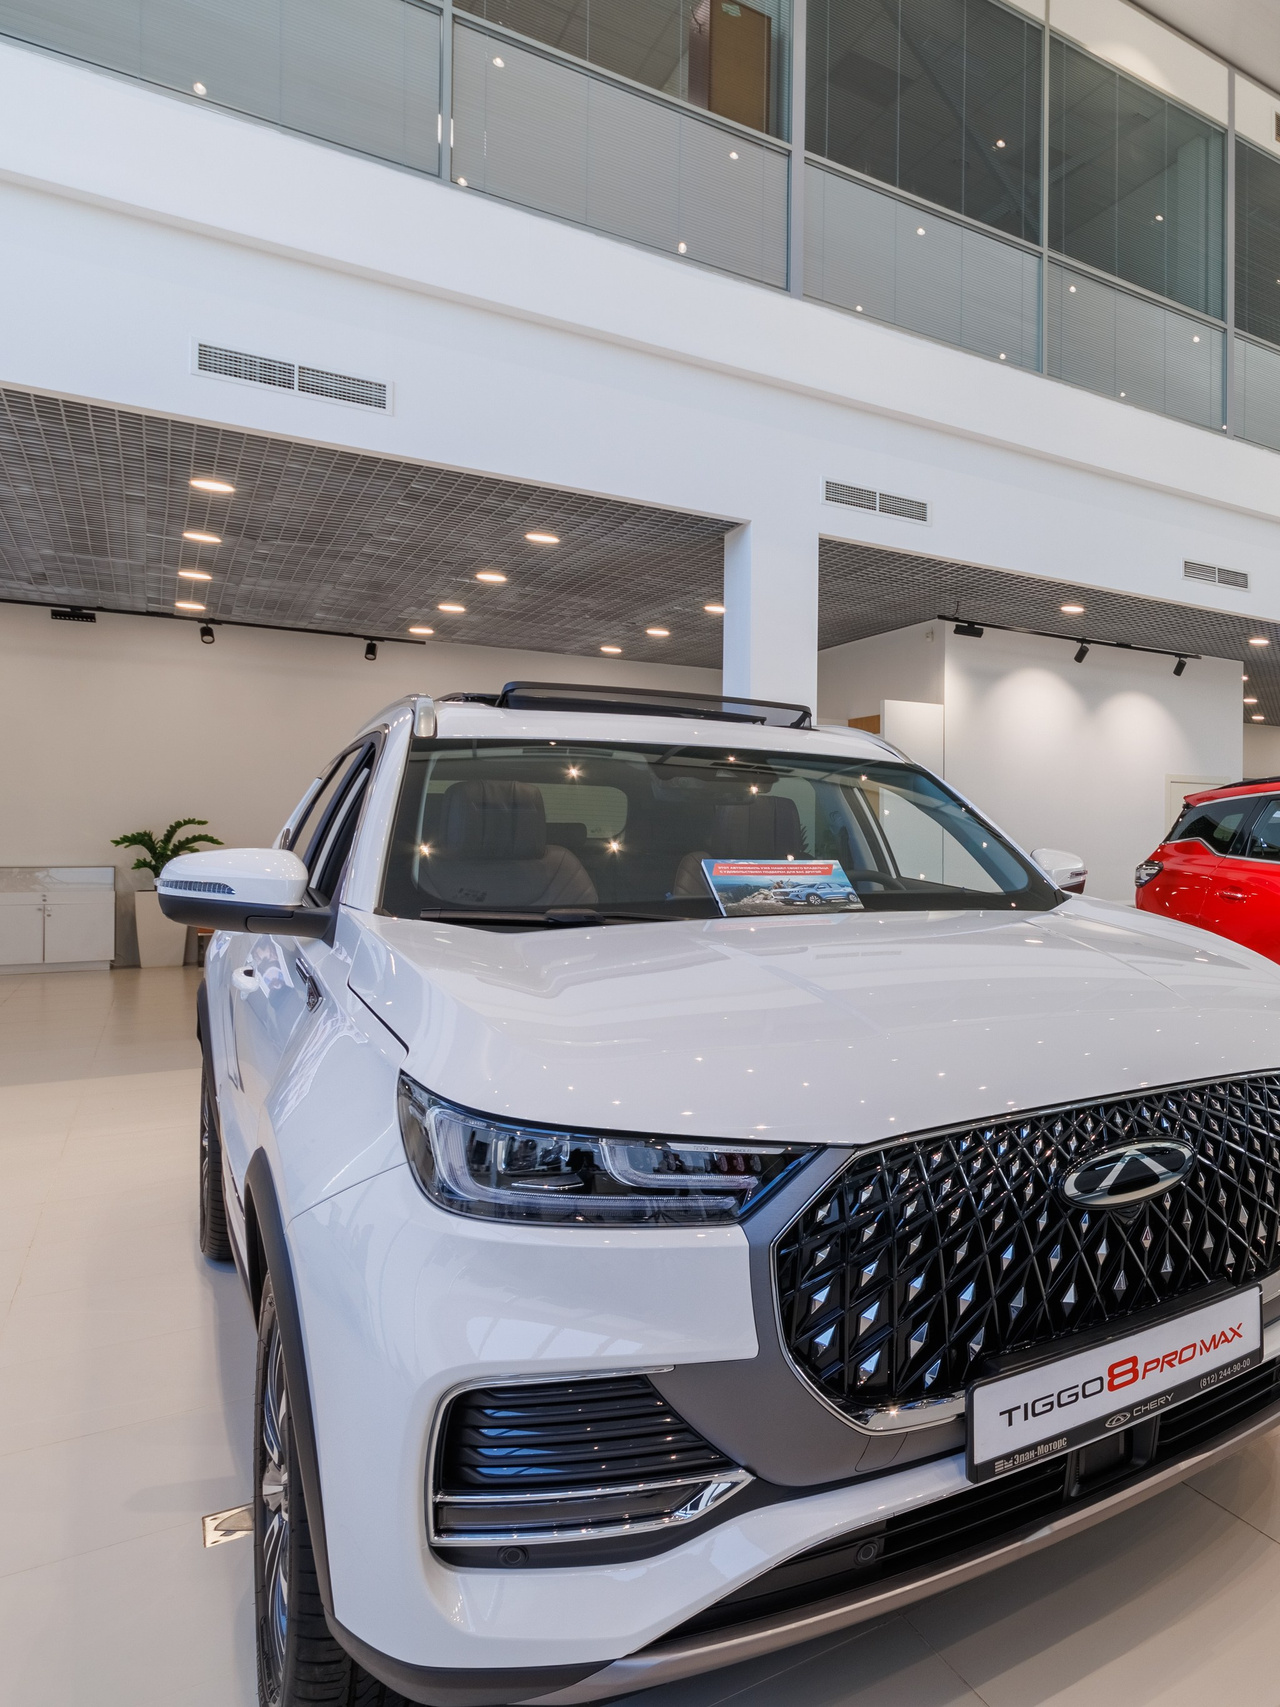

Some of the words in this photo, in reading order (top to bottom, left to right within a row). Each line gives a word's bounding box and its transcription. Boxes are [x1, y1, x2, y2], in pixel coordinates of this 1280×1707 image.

[1199, 1373, 1218, 1389] (812)
[1219, 1358, 1251, 1379] 244-90-00
[999, 1376, 1104, 1427] TIGGO
[1107, 1355, 1139, 1392] 8
[1133, 1392, 1174, 1417] CHERY
